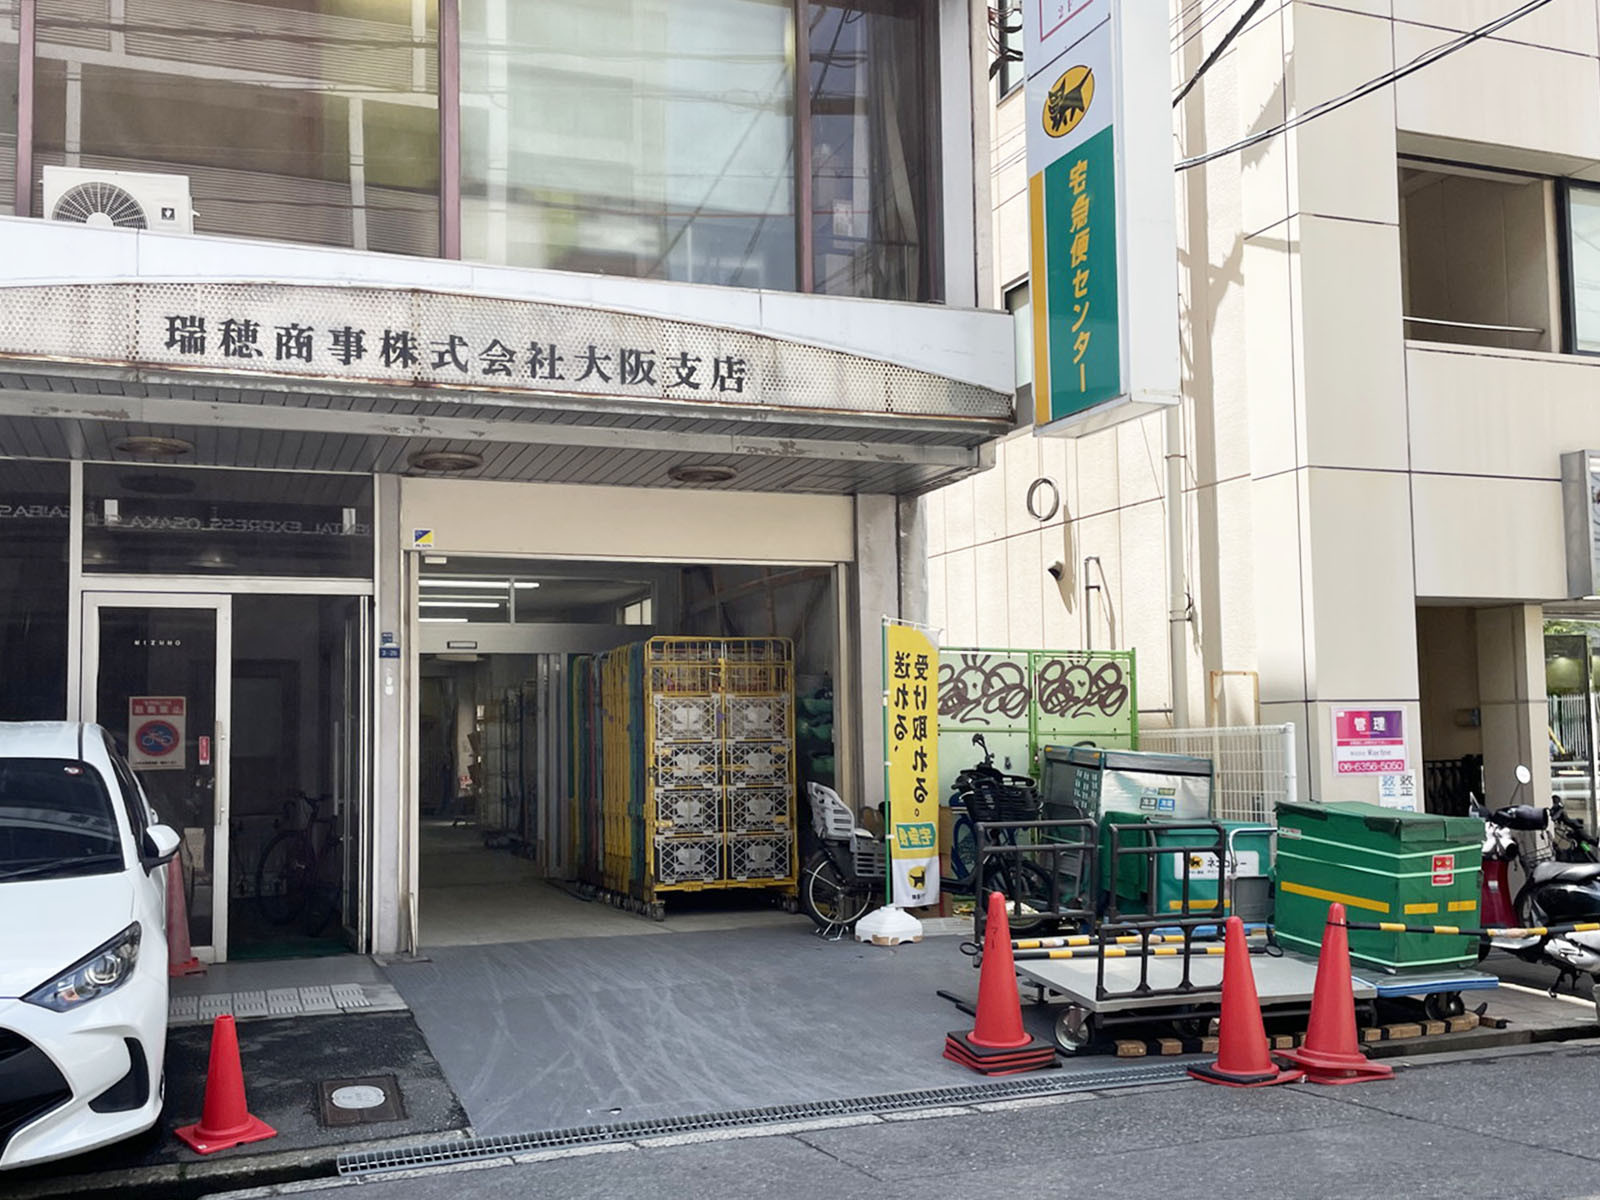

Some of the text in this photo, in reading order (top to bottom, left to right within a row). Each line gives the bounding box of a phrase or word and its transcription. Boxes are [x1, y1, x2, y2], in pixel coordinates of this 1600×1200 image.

[163, 313, 747, 394] 瑞穂商事株式会社大阪支店
[1069, 159, 1092, 394] 宅急便センター
